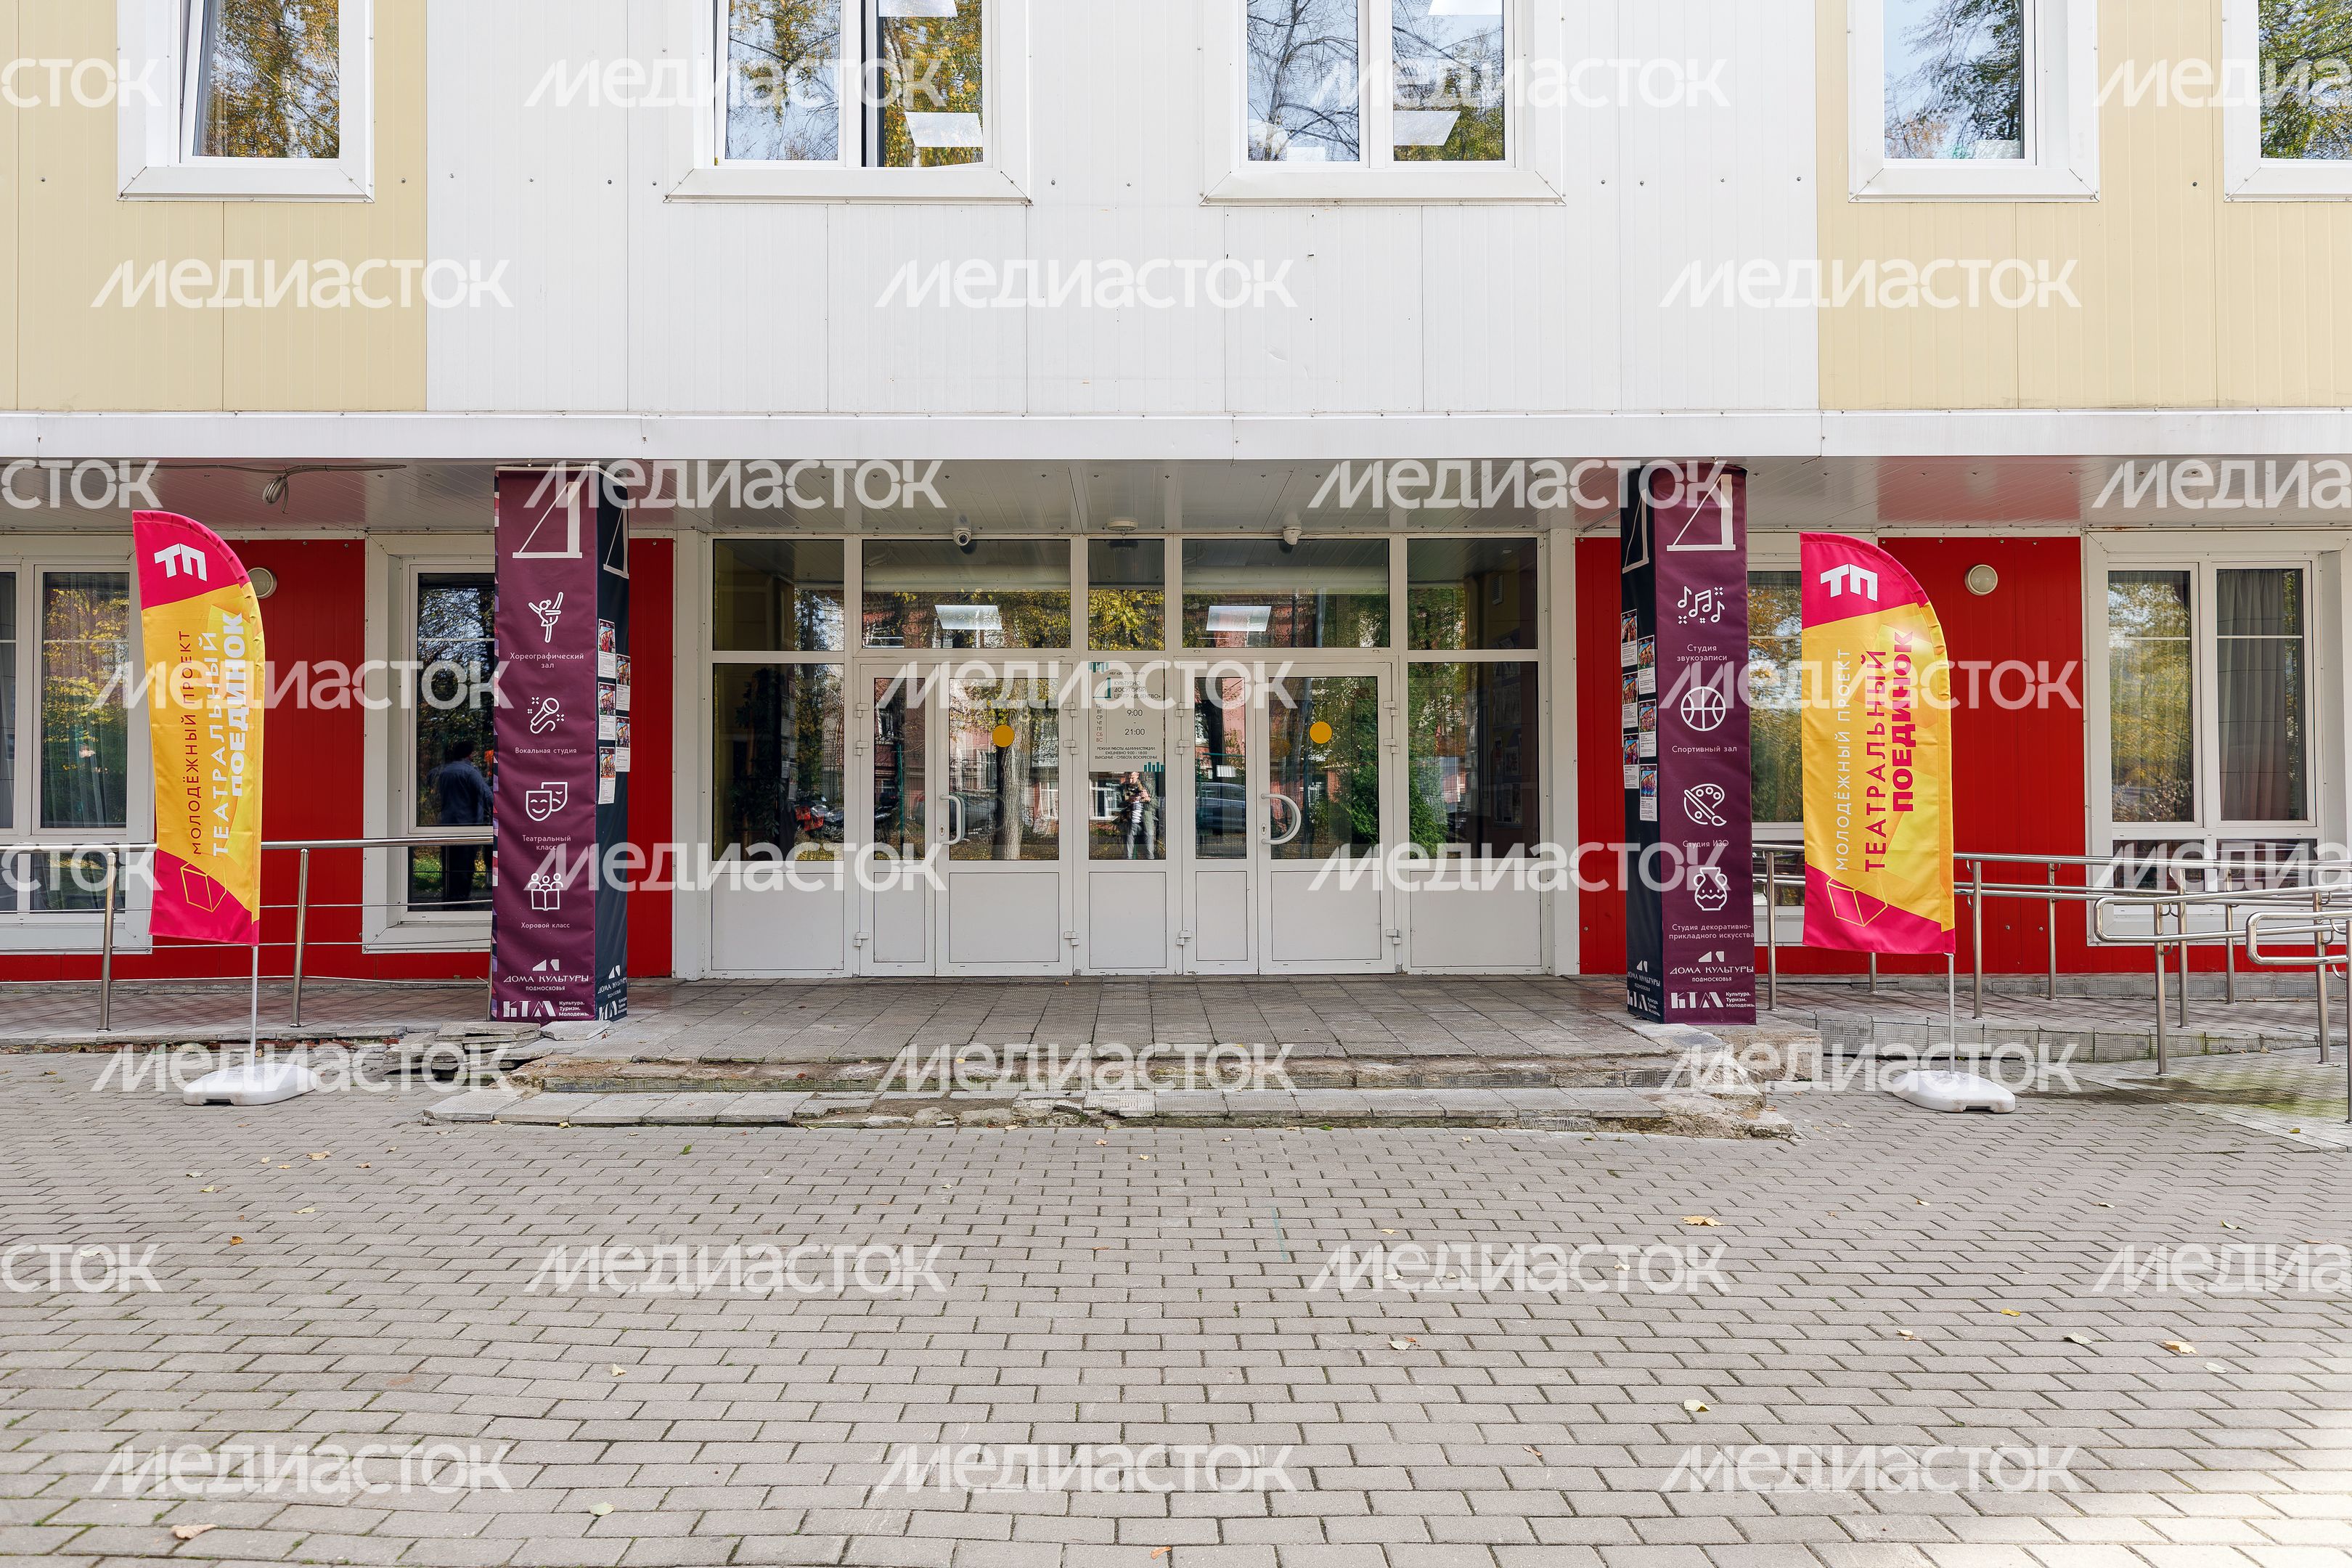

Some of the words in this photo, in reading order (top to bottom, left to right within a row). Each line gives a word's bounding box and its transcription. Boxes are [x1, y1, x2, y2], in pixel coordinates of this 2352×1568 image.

[154, 543, 207, 581] ТП
[1820, 563, 1877, 602] ТП
[179, 630, 196, 704] ПРОЕКТ
[510, 652, 584, 661] Хореографический
[1687, 644, 1717, 653] Студия
[222, 612, 250, 796] ПОЕДИНОК
[1837, 649, 1850, 722] ПРОЕКТ
[198, 632, 229, 857] ТЕАТРАЛЬНЫЙ
[1672, 745, 1720, 754] Спортивный
[1891, 631, 1916, 812] ПОЕДИНОК
[181, 714, 202, 854] МОЛОДЁЖНЫЙ
[1861, 650, 1887, 872] ТЕАТРАЛЬНЫЙ
[1834, 731, 1851, 870] МОЛОДЁЖНЫЙ
[522, 834, 571, 843] Театральный
[1682, 840, 1710, 849] Студия
[1672, 923, 1699, 932] Студия
